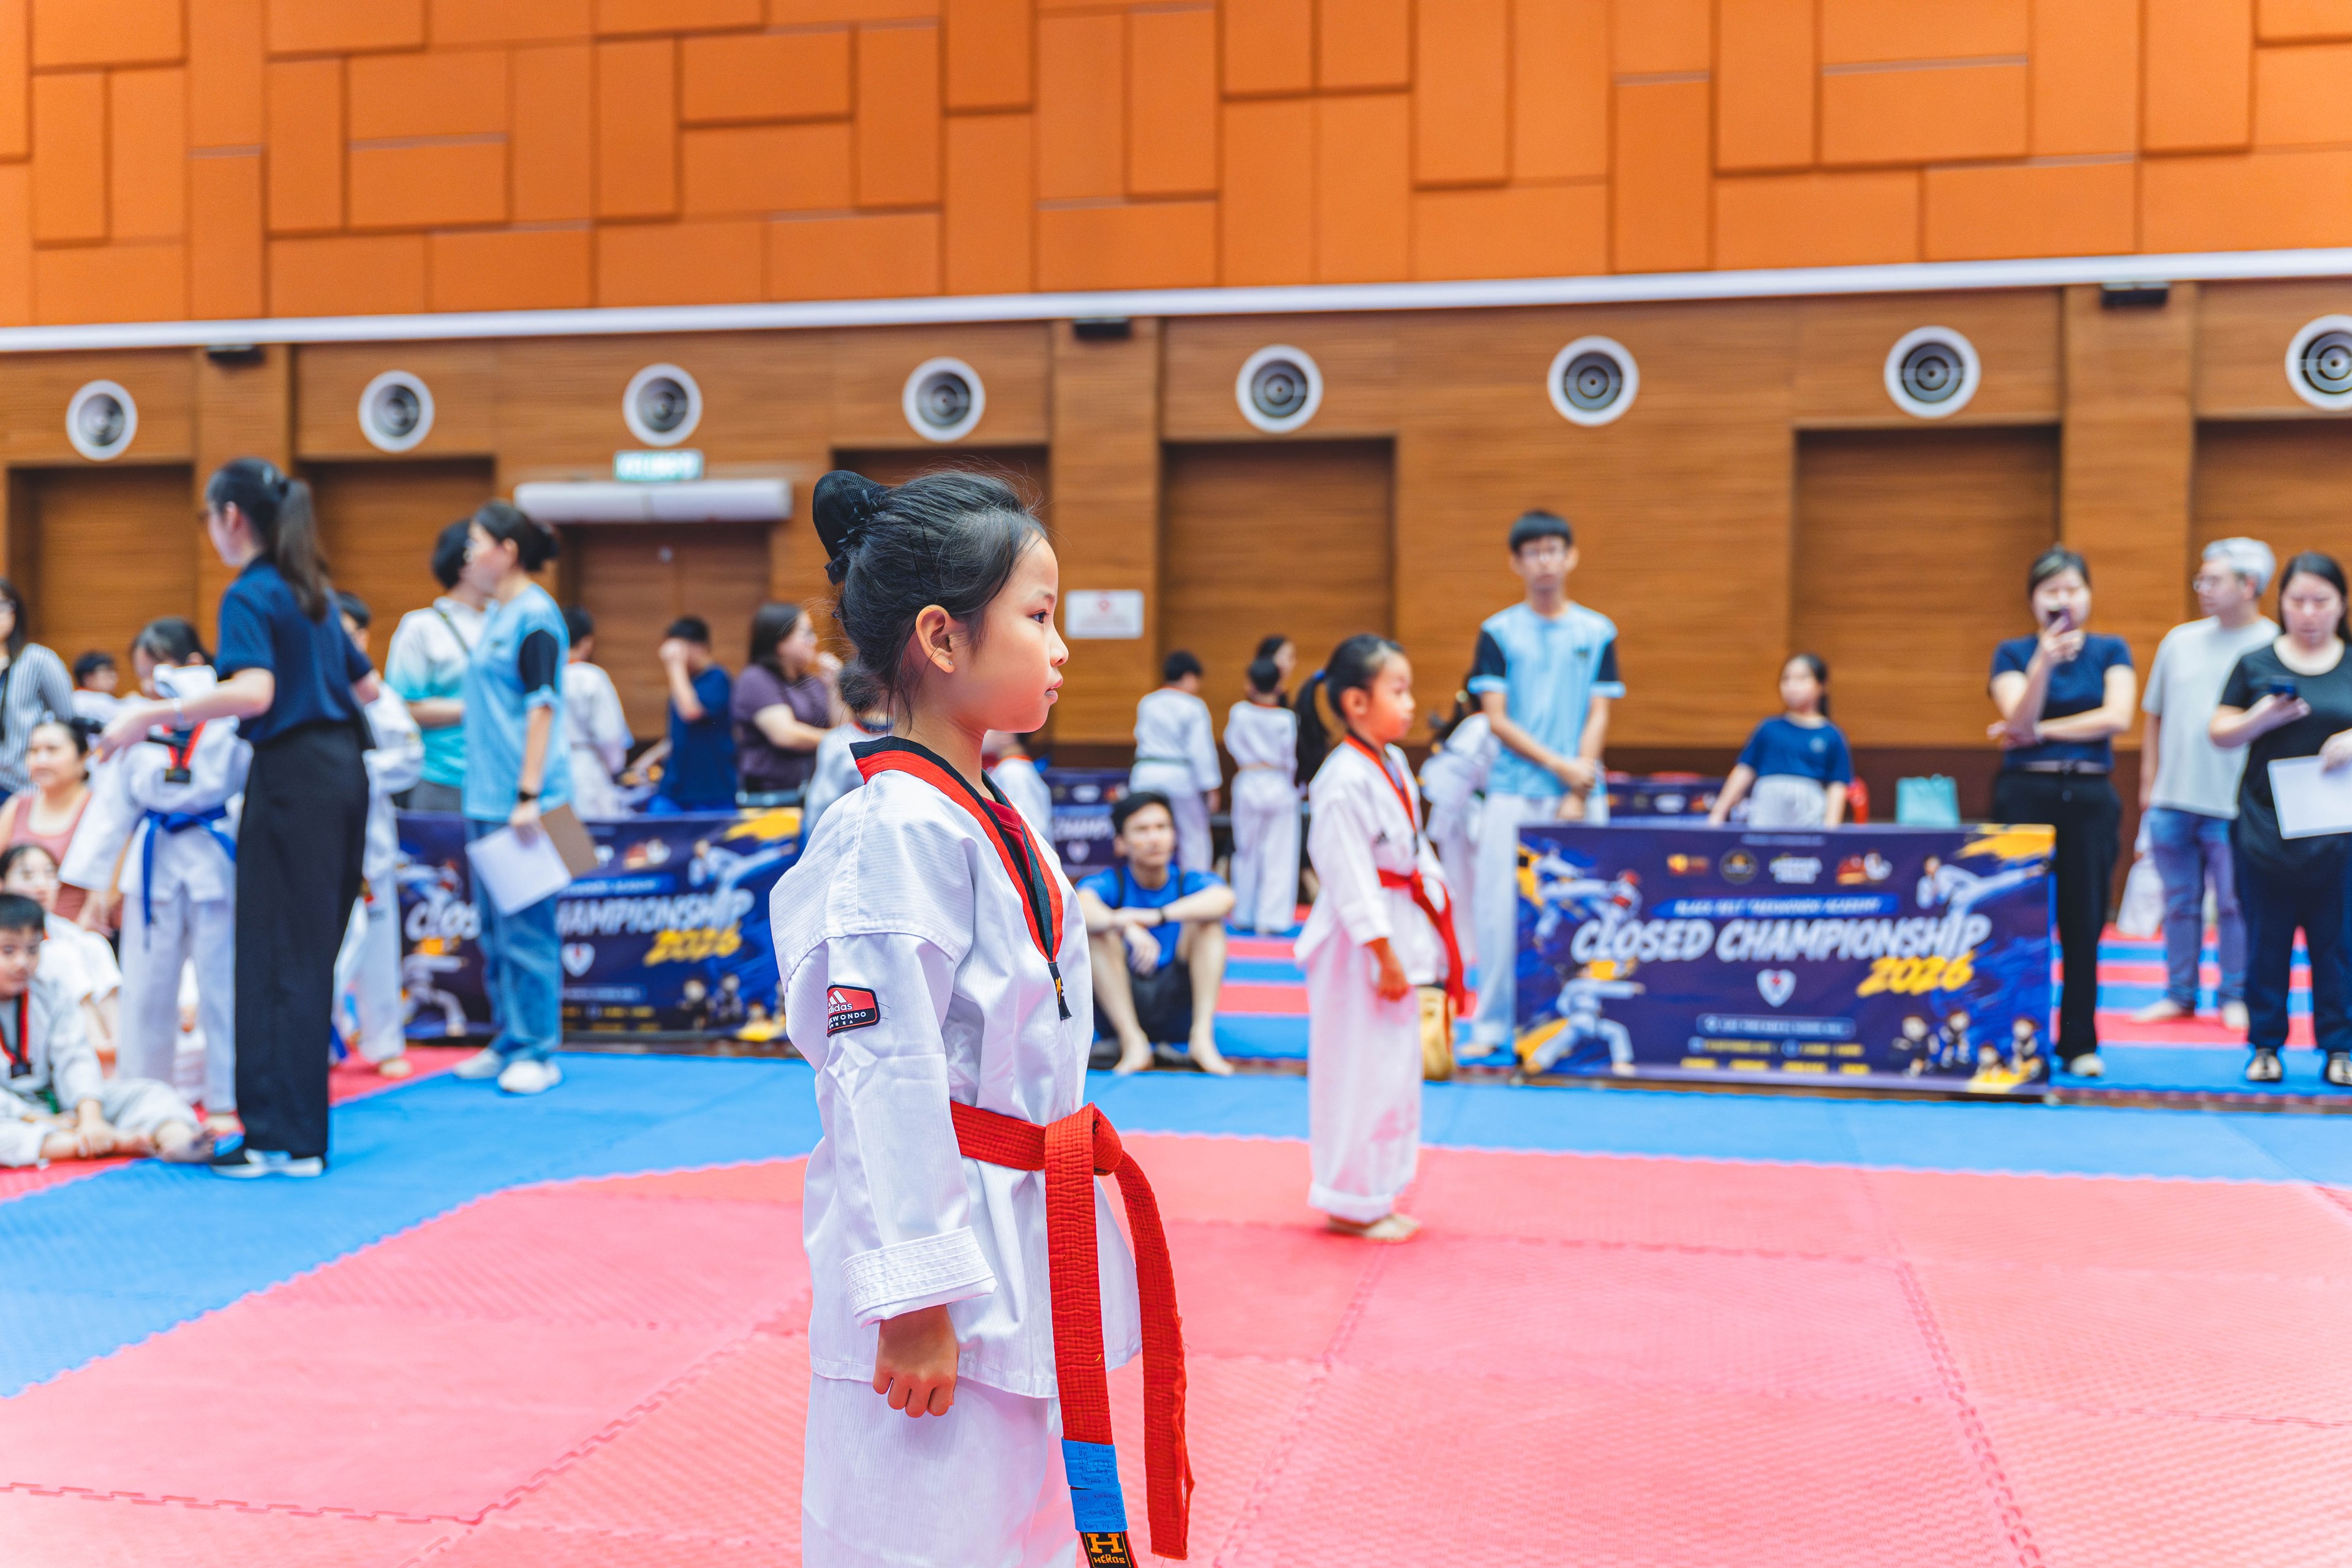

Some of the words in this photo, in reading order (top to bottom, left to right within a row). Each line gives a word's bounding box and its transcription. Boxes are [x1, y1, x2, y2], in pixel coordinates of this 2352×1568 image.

[1570, 918, 1714, 963] CLOSED
[1715, 913, 1992, 963] CHAMPIONSHIP
[1856, 950, 1975, 997] 2026
[828, 1003, 853, 1015] didas
[1087, 1533, 1123, 1553] H
[1093, 1554, 1126, 1564] HEROS
